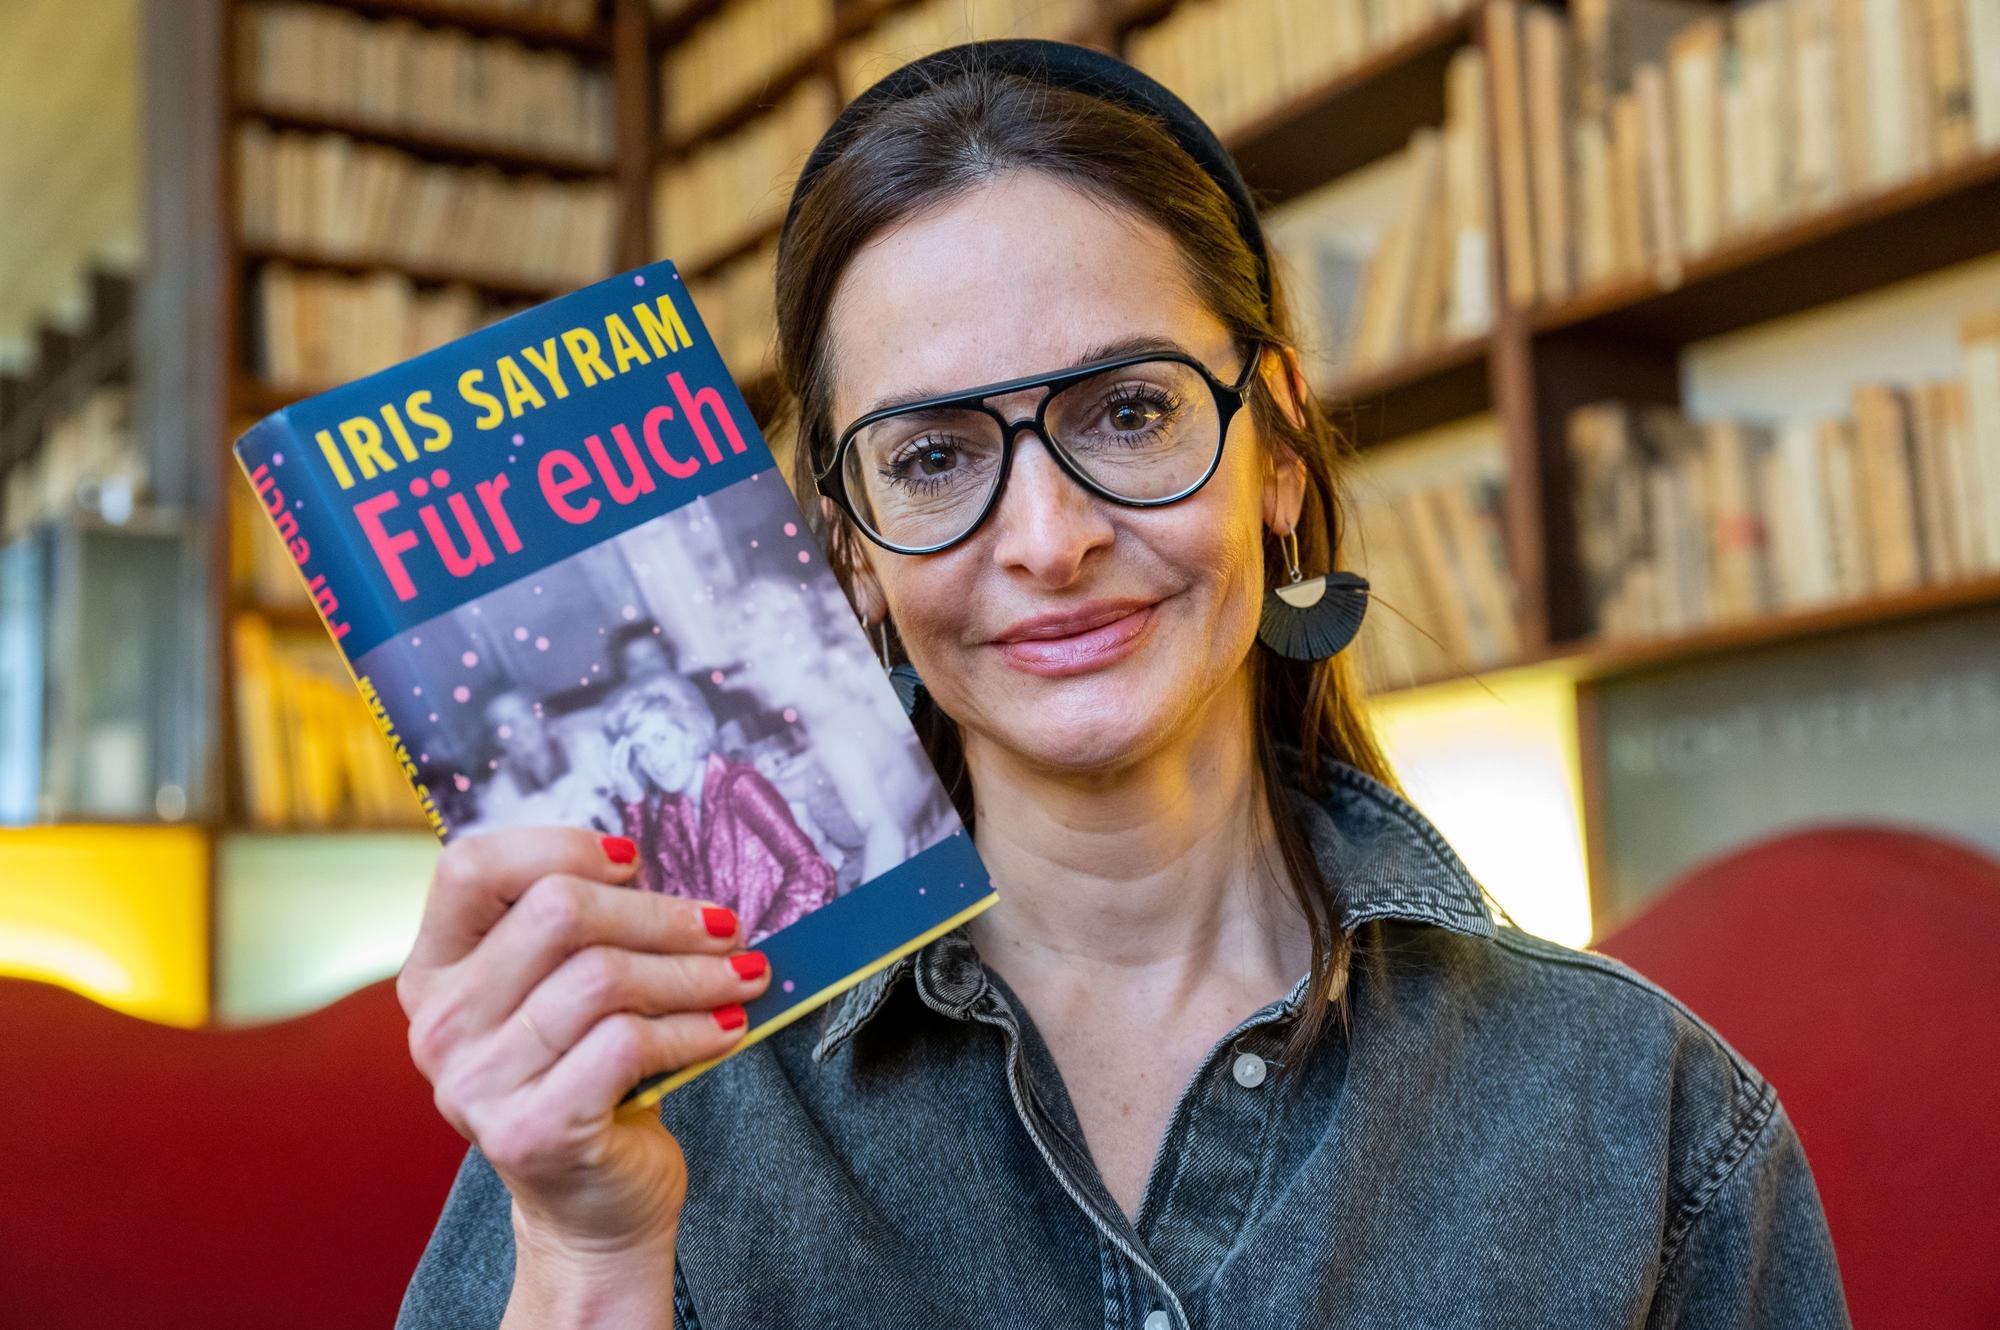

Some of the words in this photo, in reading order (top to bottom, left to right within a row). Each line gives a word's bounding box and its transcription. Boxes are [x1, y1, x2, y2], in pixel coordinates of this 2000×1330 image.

[315, 390, 453, 489] IRIS
[458, 294, 693, 430] SAYRAM
[354, 469, 524, 601] Für
[537, 371, 748, 525] euch
